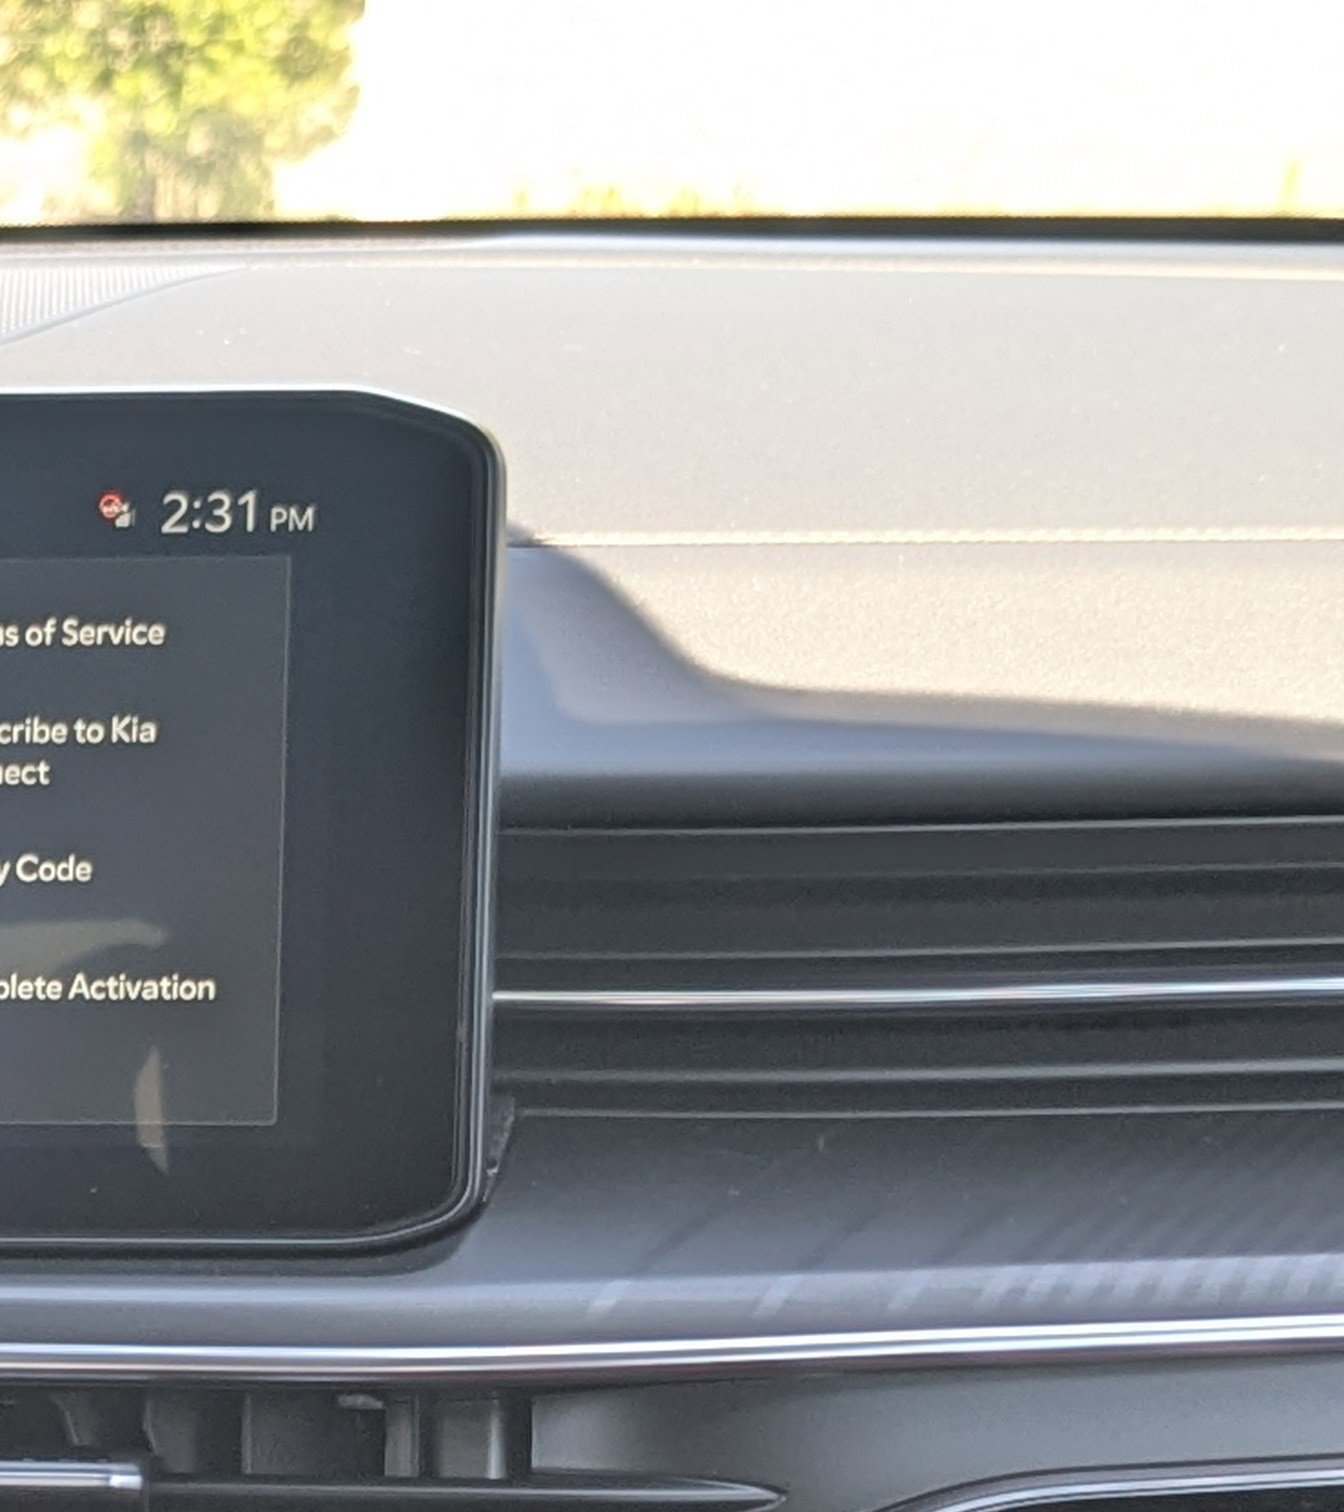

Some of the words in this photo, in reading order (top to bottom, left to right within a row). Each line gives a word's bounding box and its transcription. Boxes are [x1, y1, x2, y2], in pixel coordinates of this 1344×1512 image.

[162, 490, 257, 533] 2:31
[270, 504, 314, 532] PM
[25, 618, 56, 646] of
[62, 619, 165, 646] Service
[74, 719, 104, 743] to
[112, 716, 156, 742] Kia
[16, 854, 92, 882] Code
[69, 973, 215, 1000] Activation
